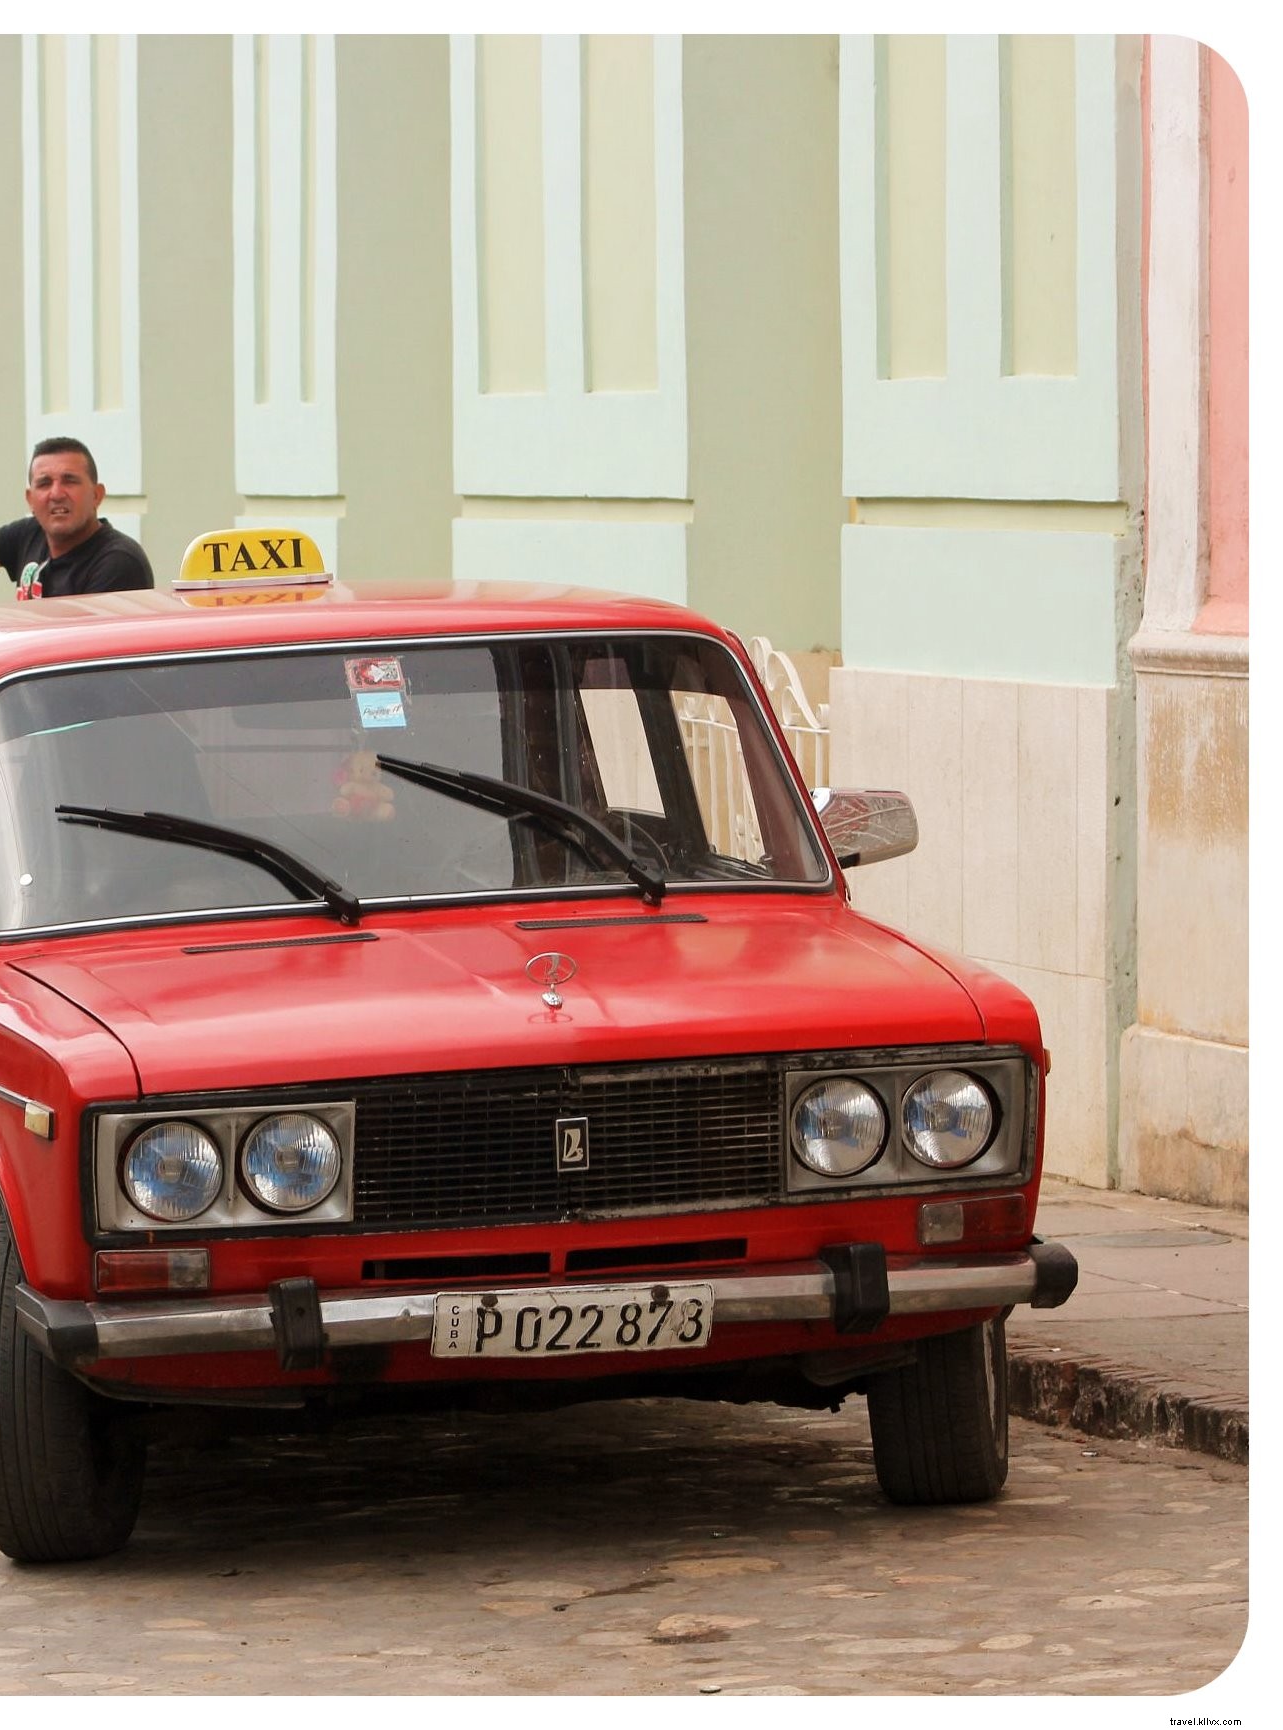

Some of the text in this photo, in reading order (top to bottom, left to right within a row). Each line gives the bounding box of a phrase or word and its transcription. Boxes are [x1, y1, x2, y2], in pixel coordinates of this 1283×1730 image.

[203, 538, 305, 573] TAXI
[448, 1305, 460, 1349] CUBA
[475, 1306, 503, 1352] P
[514, 1304, 604, 1351] 022
